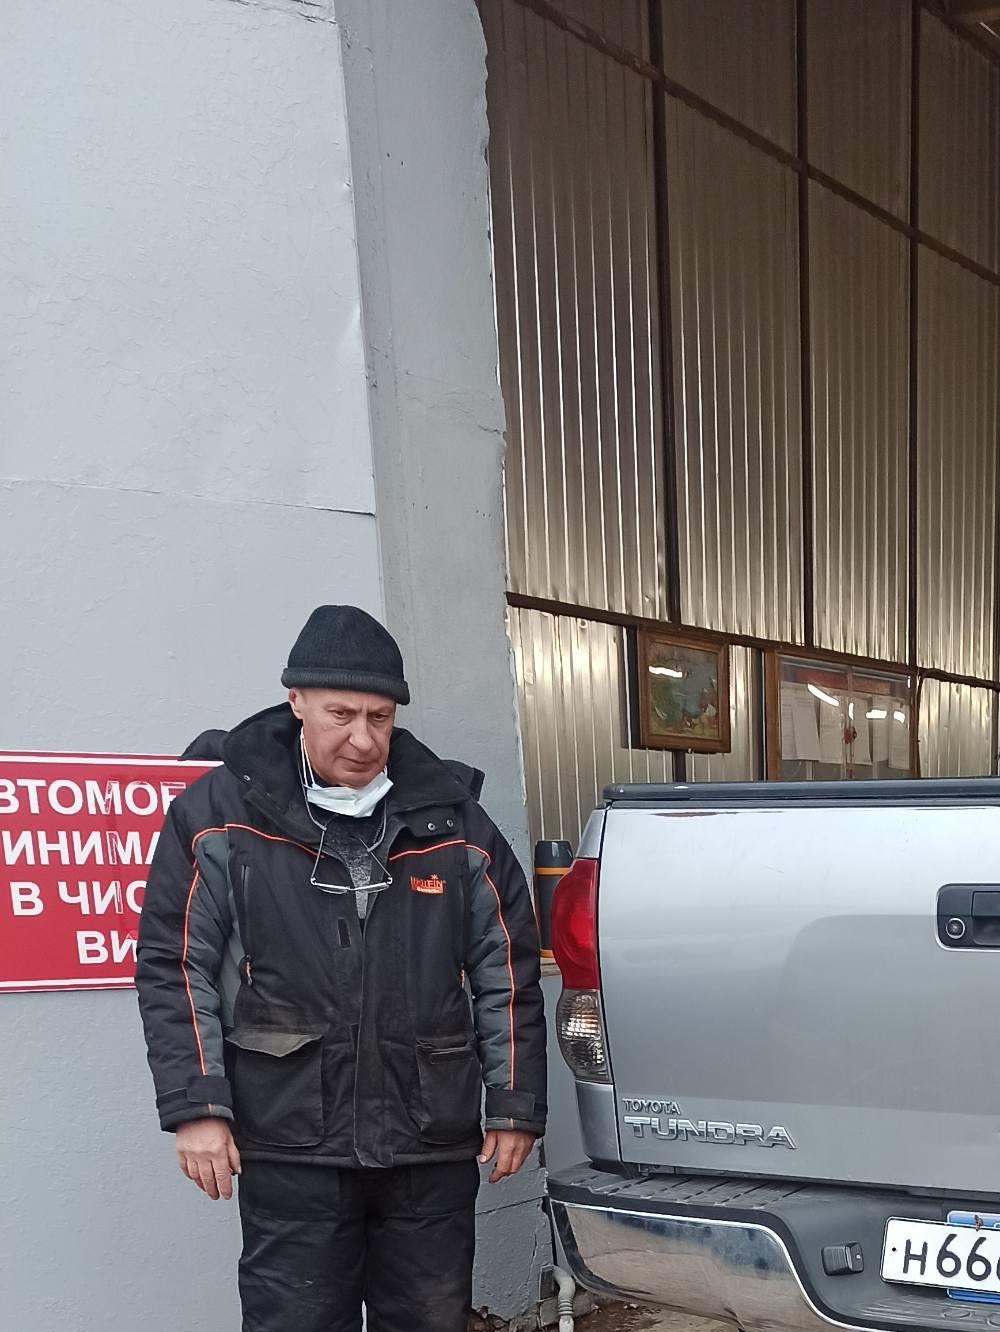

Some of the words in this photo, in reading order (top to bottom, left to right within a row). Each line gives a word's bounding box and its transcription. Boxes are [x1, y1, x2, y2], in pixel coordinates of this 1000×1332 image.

[9, 881, 44, 916] В
[622, 1098, 682, 1116] TOYOTA
[624, 1115, 797, 1150] TUNDRA
